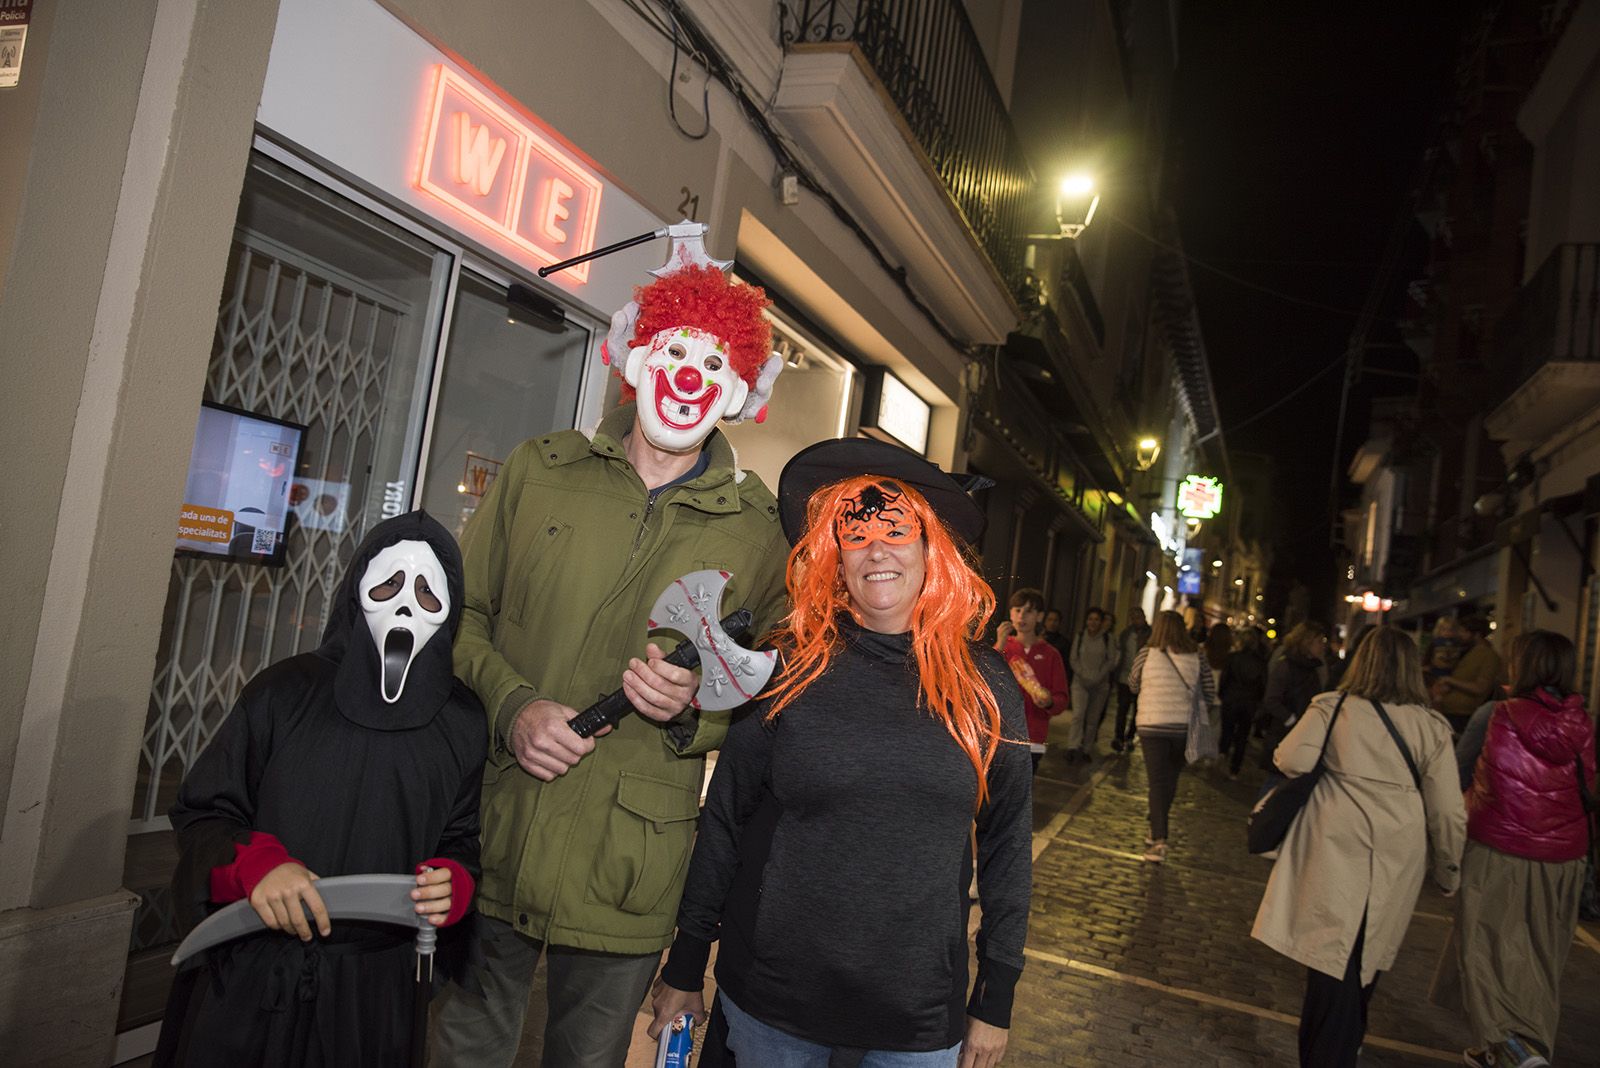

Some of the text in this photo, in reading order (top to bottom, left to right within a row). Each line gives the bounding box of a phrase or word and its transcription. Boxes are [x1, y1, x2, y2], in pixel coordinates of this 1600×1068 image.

[452, 111, 575, 245] WE
[677, 186, 699, 222] 21
[199, 514, 216, 523] una
[217, 515, 229, 525] de
